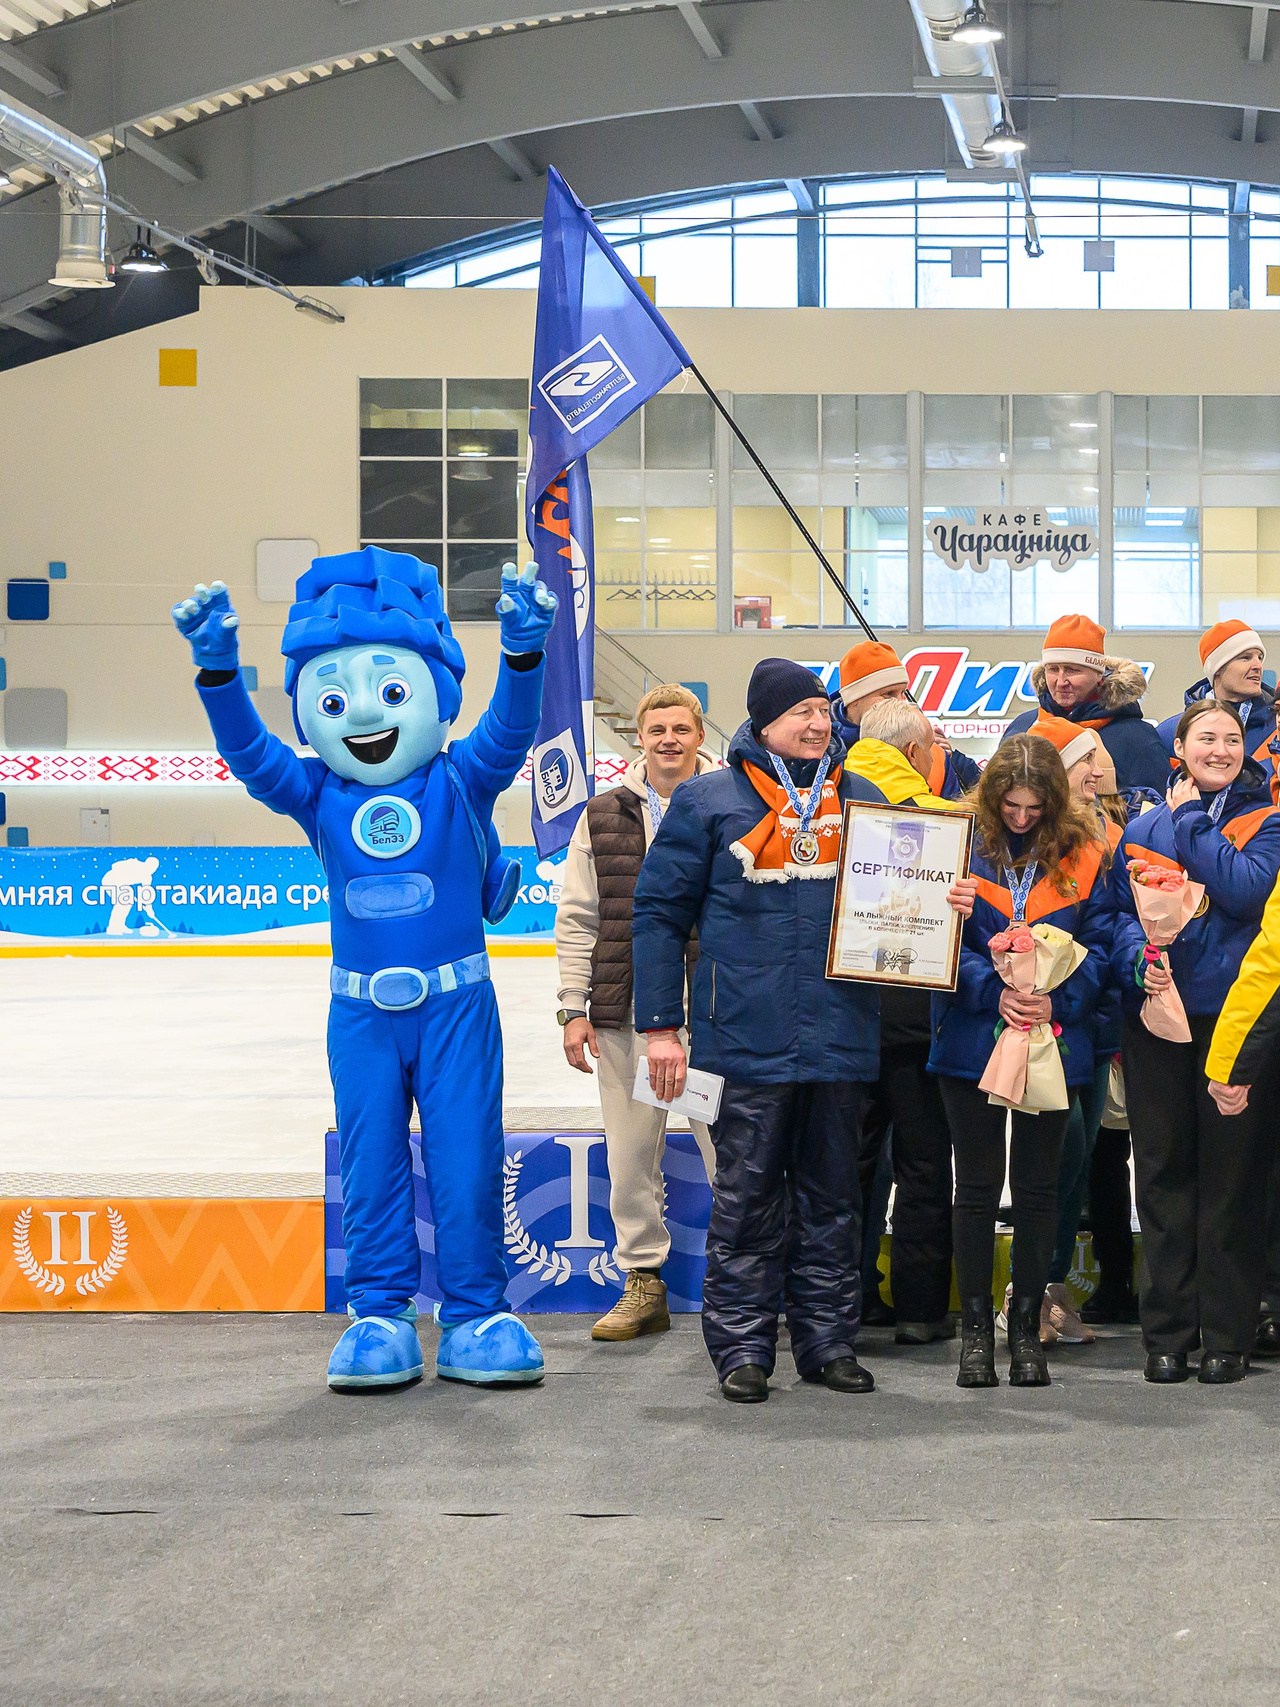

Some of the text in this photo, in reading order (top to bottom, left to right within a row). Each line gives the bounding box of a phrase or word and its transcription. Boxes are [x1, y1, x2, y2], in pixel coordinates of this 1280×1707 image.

[983, 513, 1041, 526] КАФЕ
[933, 525, 1091, 565] Чараўніца
[541, 770, 556, 802] БИСП
[372, 835, 405, 845] БелЭЗ
[851, 861, 955, 884] СЕРТИФИКАТ
[82, 884, 278, 911] спартакиада
[853, 910, 865, 918] НА
[904, 916, 944, 926] КОМПЛЕКТ
[43, 1211, 97, 1265] II
